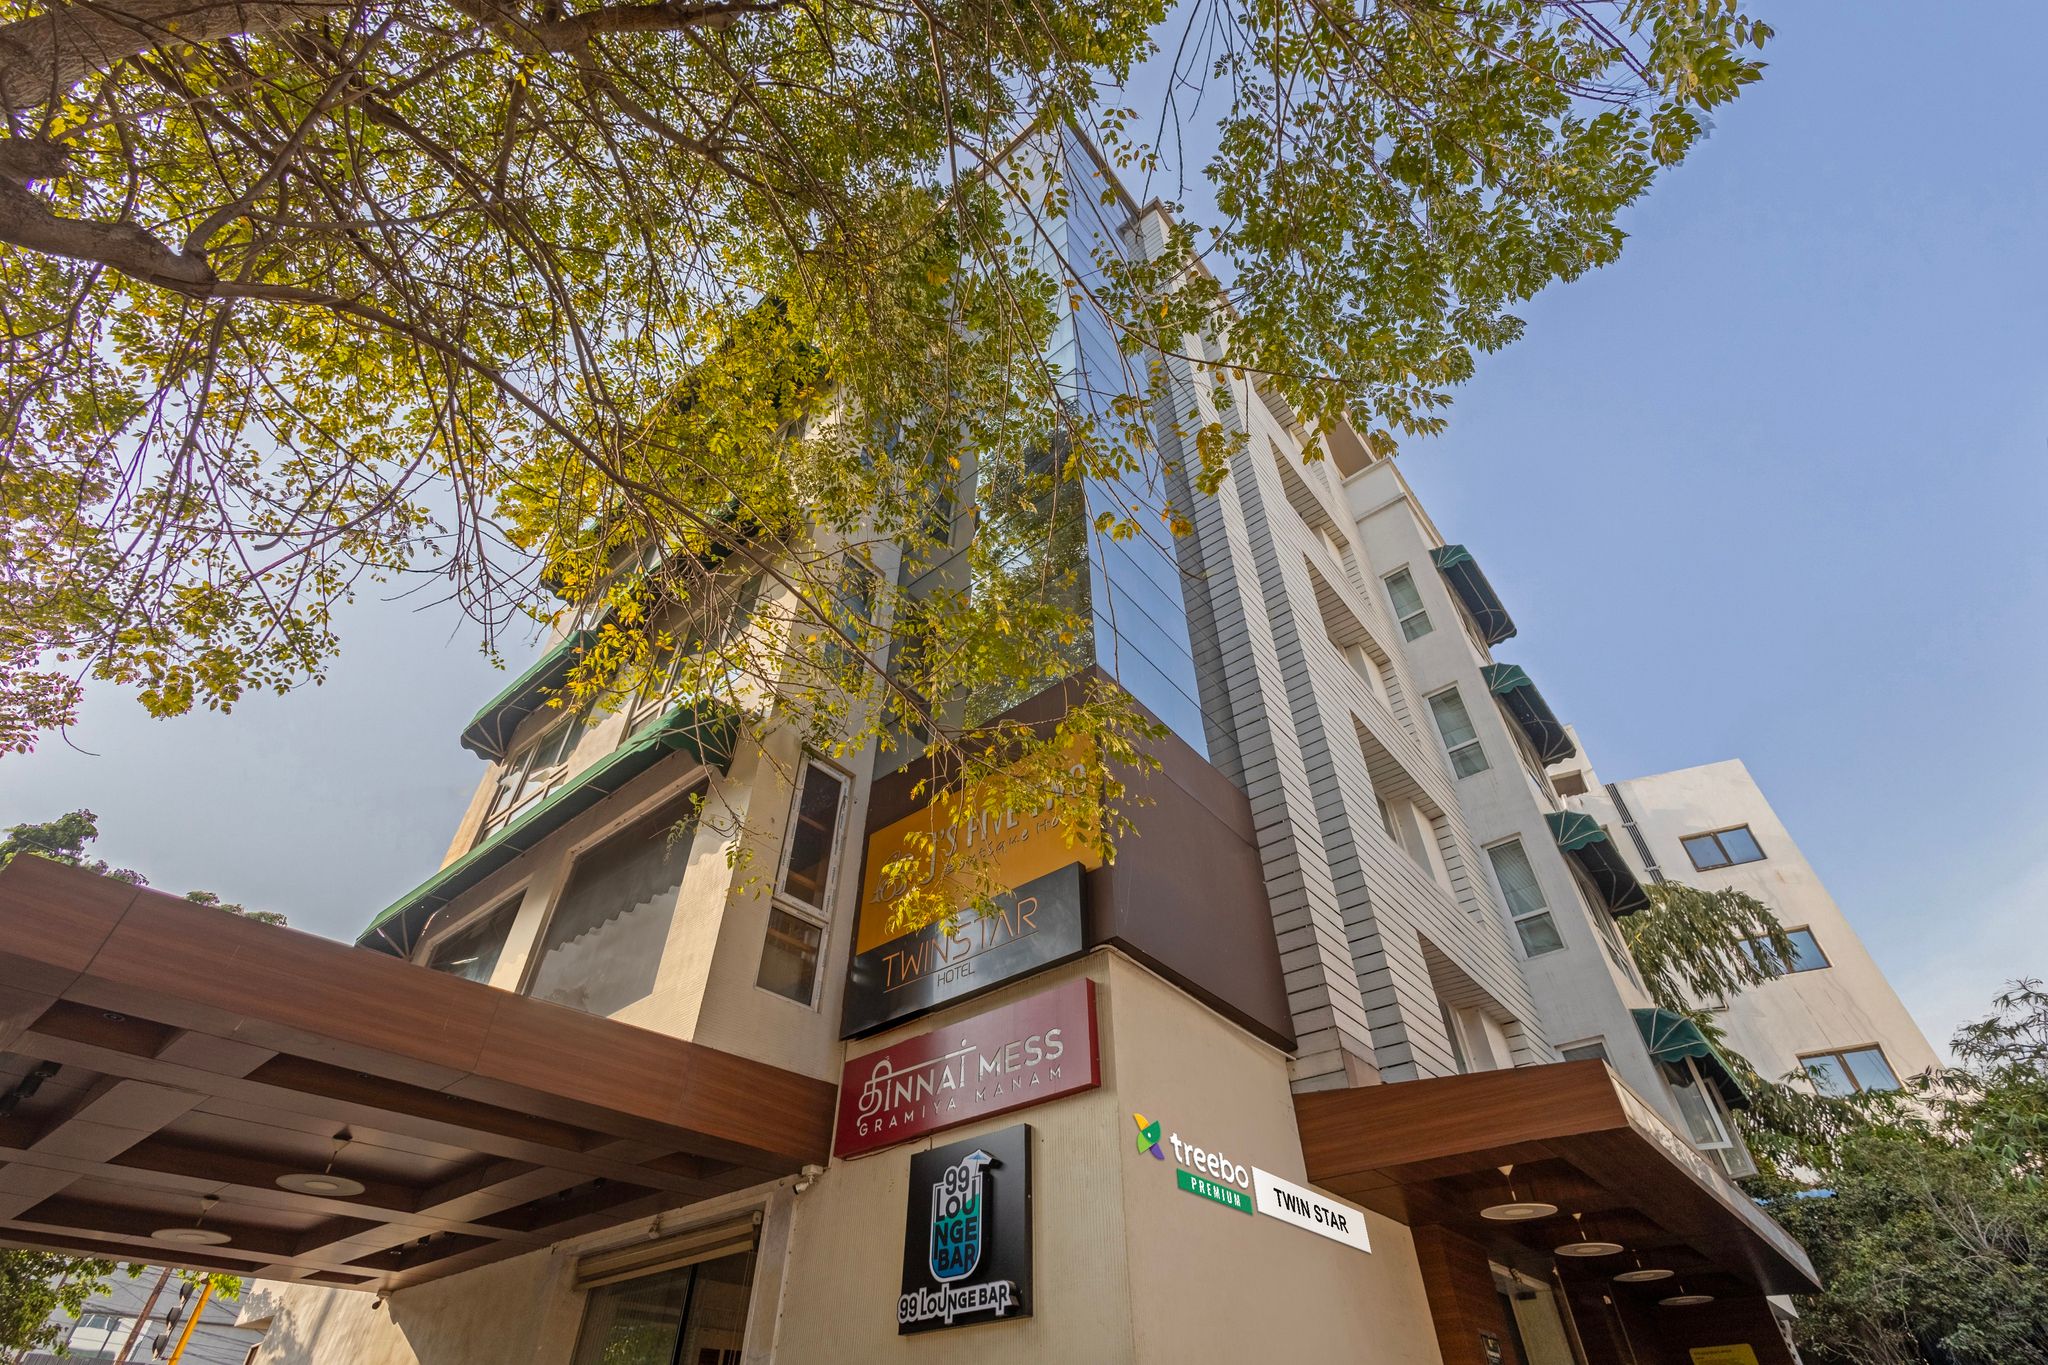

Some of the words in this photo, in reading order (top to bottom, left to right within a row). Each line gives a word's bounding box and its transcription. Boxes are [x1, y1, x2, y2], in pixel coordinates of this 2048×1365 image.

[937, 962, 976, 987] HOTEL
[979, 1028, 1064, 1082] MESS
[859, 1097, 957, 1137] GRAMIYA
[975, 1066, 1062, 1103] MANAM
[945, 1166, 970, 1195] 99
[1170, 1132, 1249, 1189] treebo
[936, 1179, 977, 1223] LOU
[1190, 1176, 1241, 1207] PREMIUM
[1273, 1188, 1312, 1219] TWIN
[1314, 1204, 1349, 1233] STAR
[934, 1216, 977, 1259] NGE
[937, 1243, 976, 1273] BAR
[900, 1297, 918, 1319] 99
[978, 1284, 1009, 1311] BAR
